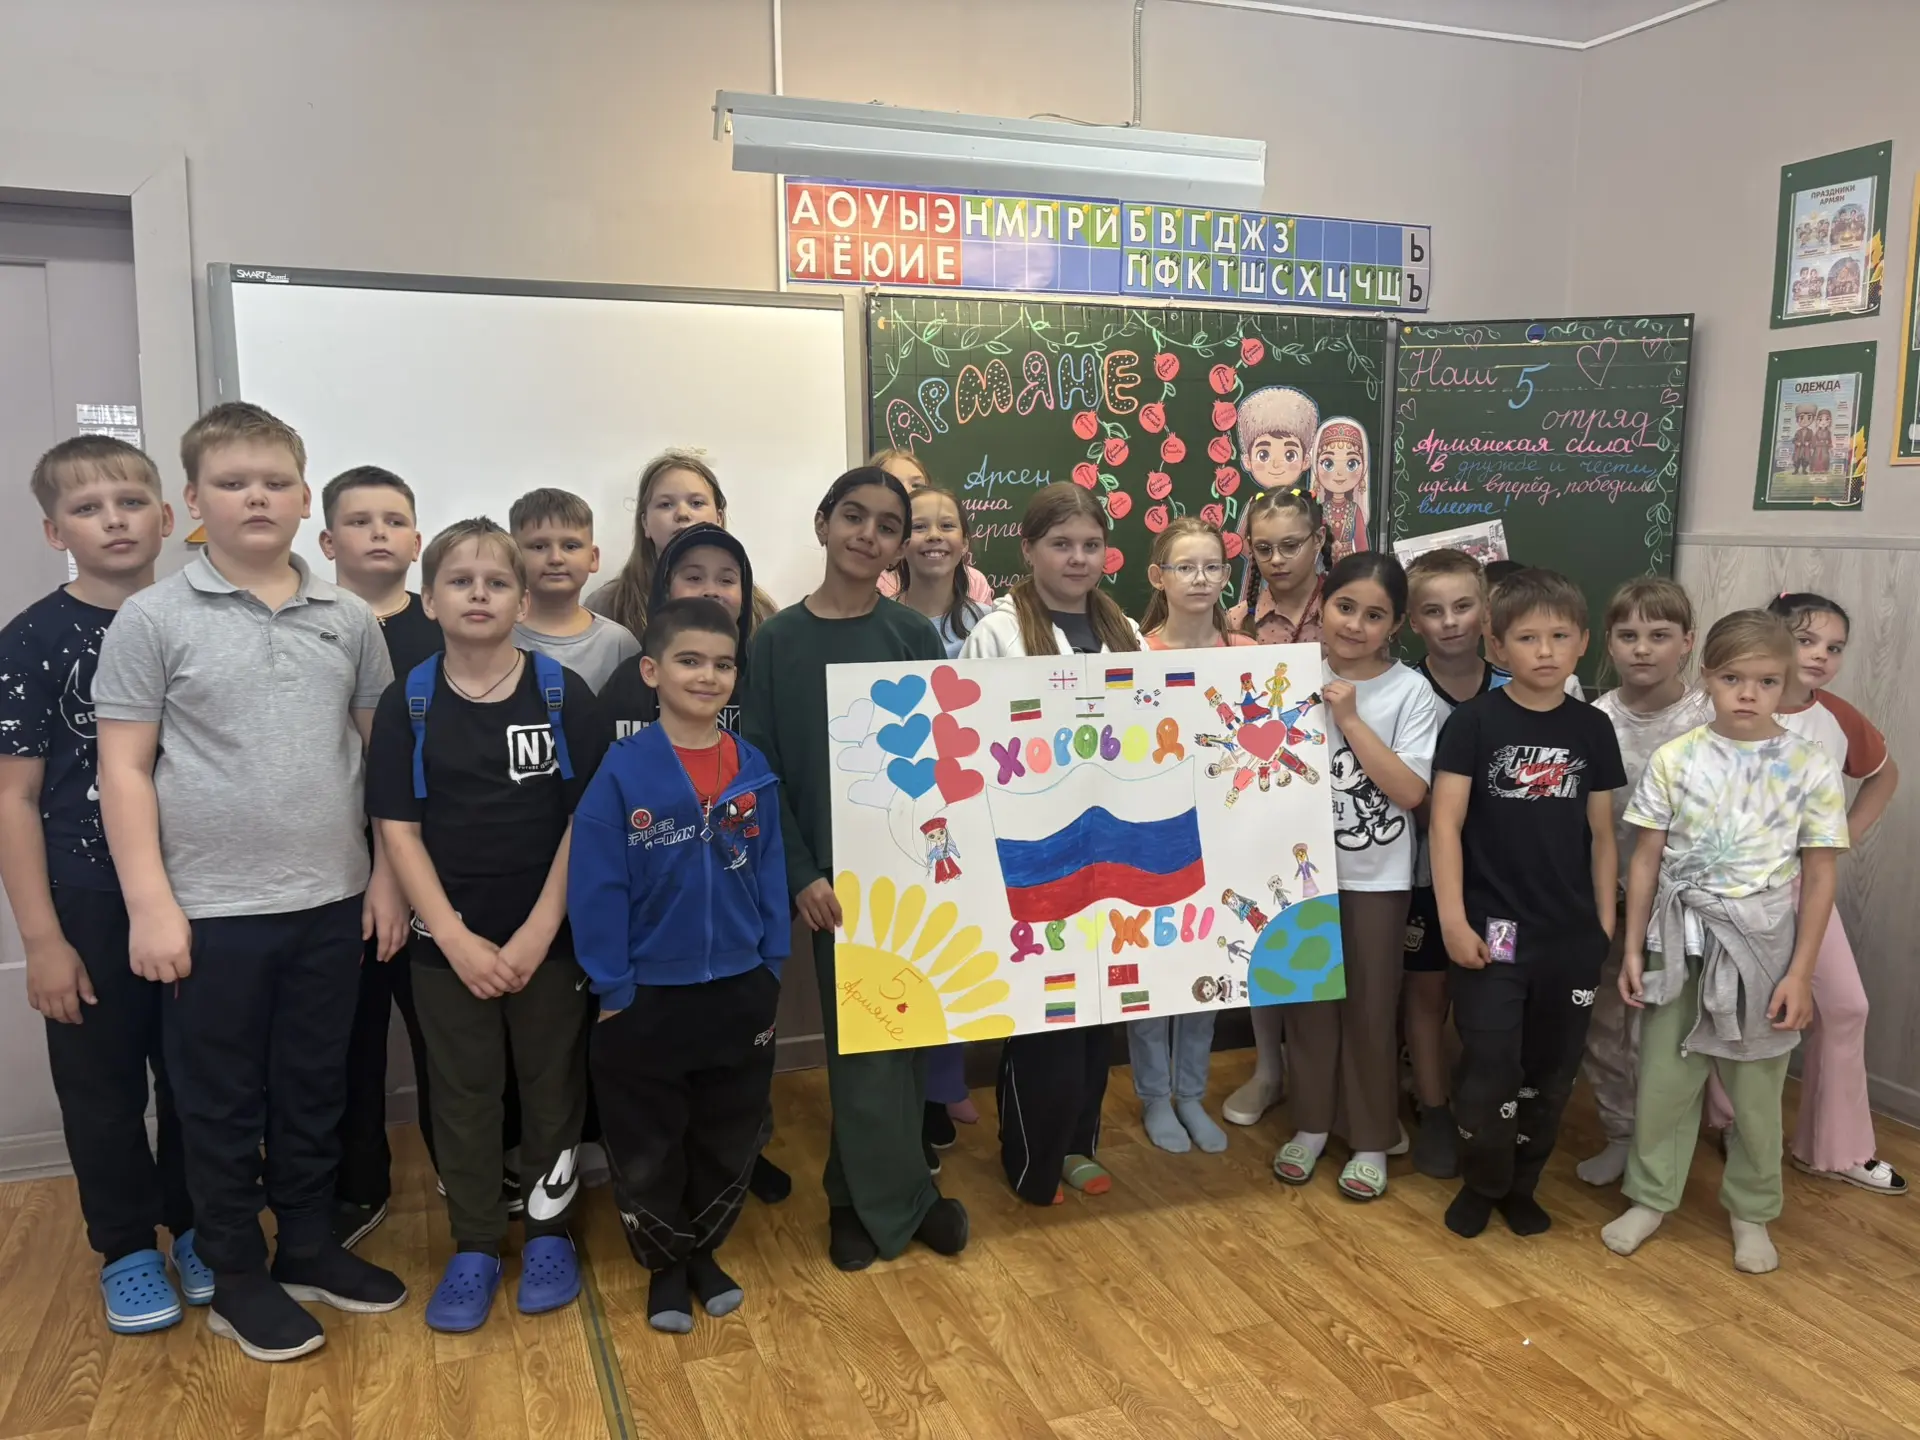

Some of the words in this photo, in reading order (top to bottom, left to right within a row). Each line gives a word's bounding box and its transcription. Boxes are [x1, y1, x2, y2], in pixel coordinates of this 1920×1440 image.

[1811, 184, 1856, 199] ПРАЗДНИКИ
[1819, 194, 1846, 206] АРМЯН
[237, 269, 266, 279] SMART
[1409, 348, 1498, 386] Наш
[1508, 362, 1551, 410] 5
[1795, 380, 1841, 393] ОДЕЖДА
[886, 350, 1141, 453] АРМЯНЕ
[1542, 408, 1659, 447] отряд
[963, 454, 1051, 499] Арсен
[989, 717, 1186, 786] ХОРОВОД
[1010, 902, 1215, 963] ДРУЖБЫ
[878, 967, 923, 1000] 5
